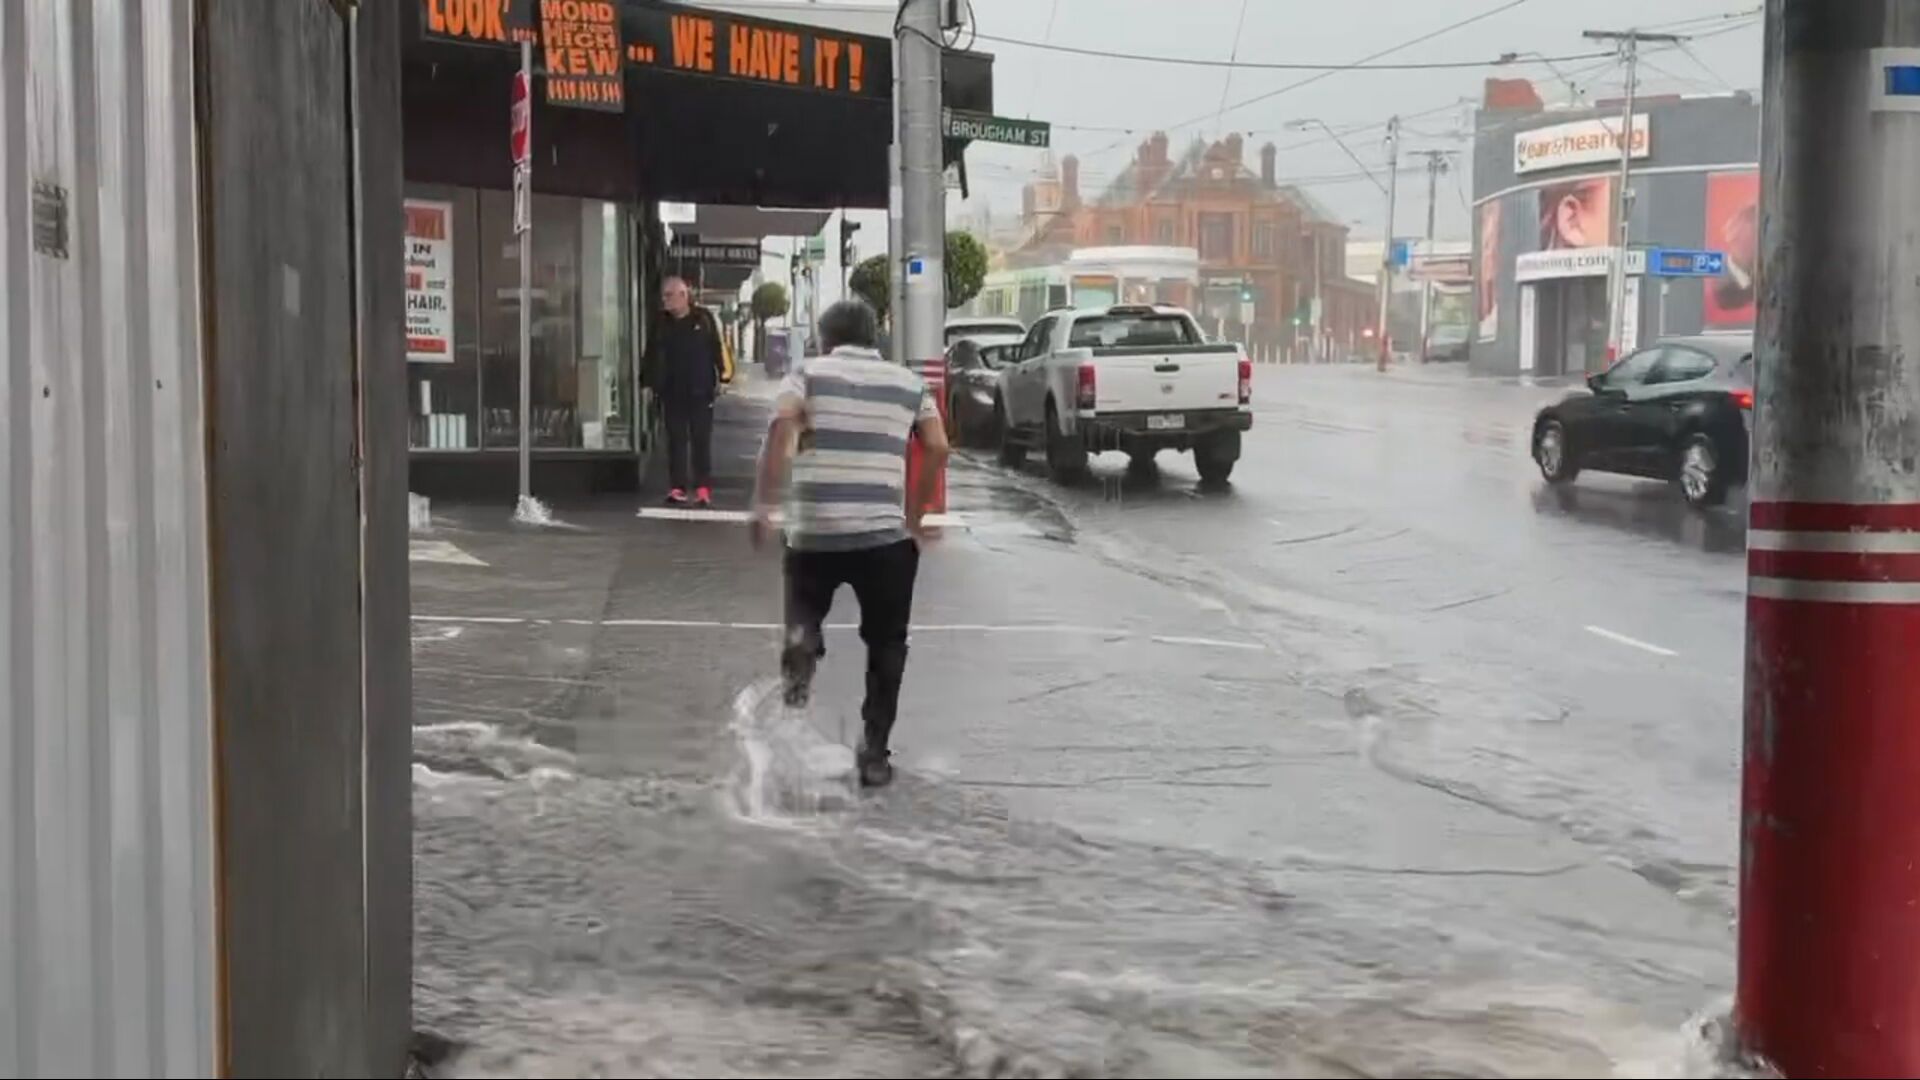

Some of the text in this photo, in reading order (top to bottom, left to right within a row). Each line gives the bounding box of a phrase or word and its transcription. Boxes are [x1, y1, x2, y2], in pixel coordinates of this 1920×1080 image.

[545, 47, 620, 76] KEW
[671, 14, 714, 72] WE
[729, 23, 801, 84] HAVE
[814, 37, 840, 90] IT
[951, 119, 1048, 145] BROUGHAM ST
[407, 294, 446, 311] HAIR.
